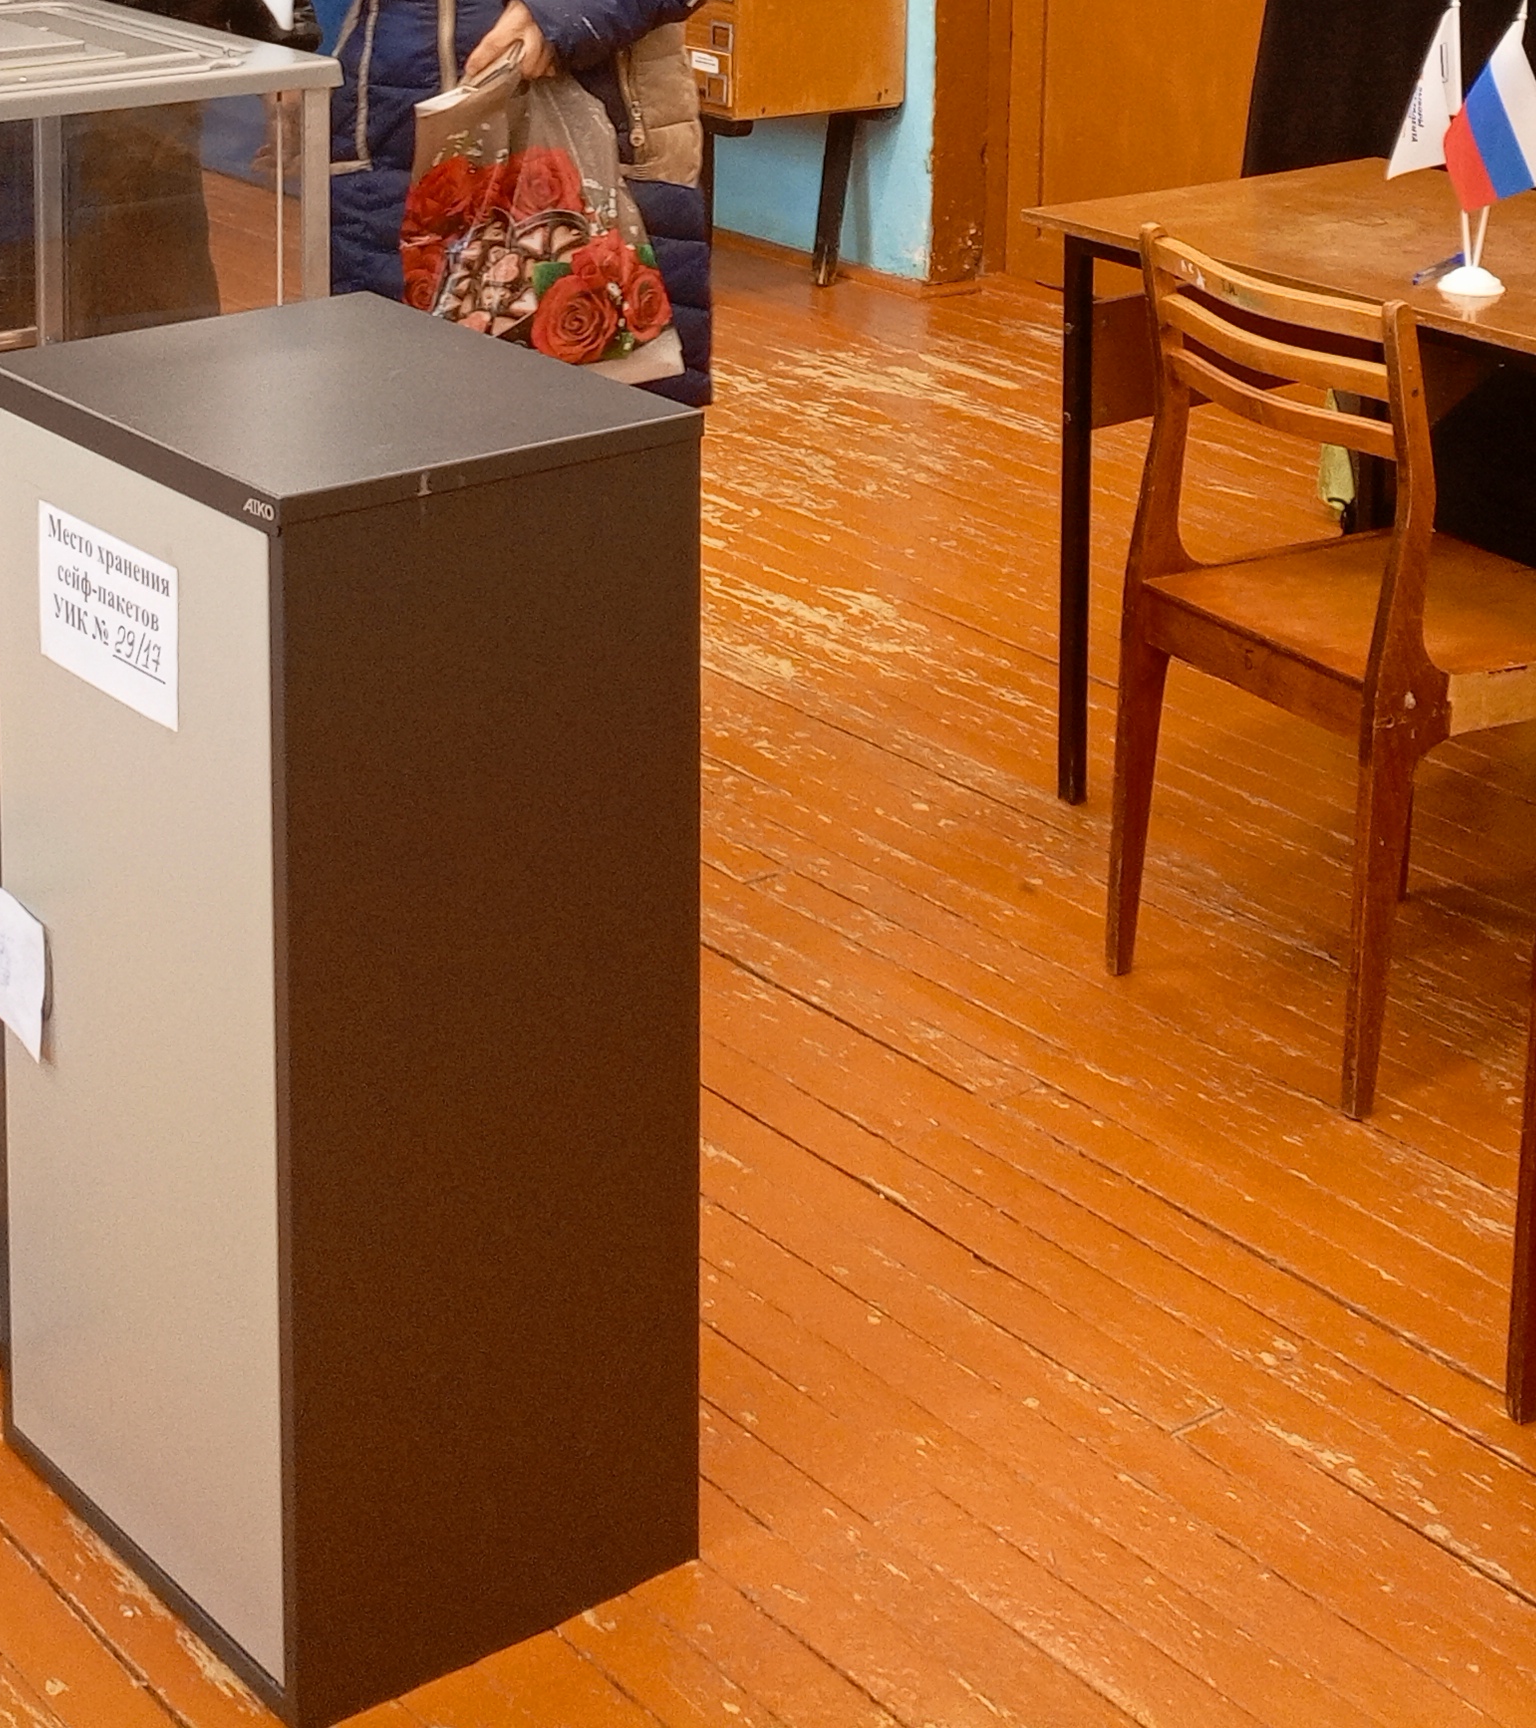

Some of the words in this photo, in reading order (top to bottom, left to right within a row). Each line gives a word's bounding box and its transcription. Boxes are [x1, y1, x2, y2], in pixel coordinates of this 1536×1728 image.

[243, 498, 274, 521] AIKO
[48, 513, 93, 558] Место
[97, 544, 170, 597] хранения
[53, 592, 88, 636] УИК
[92, 615, 109, 646] №
[57, 563, 160, 632] сейф-пакетов
